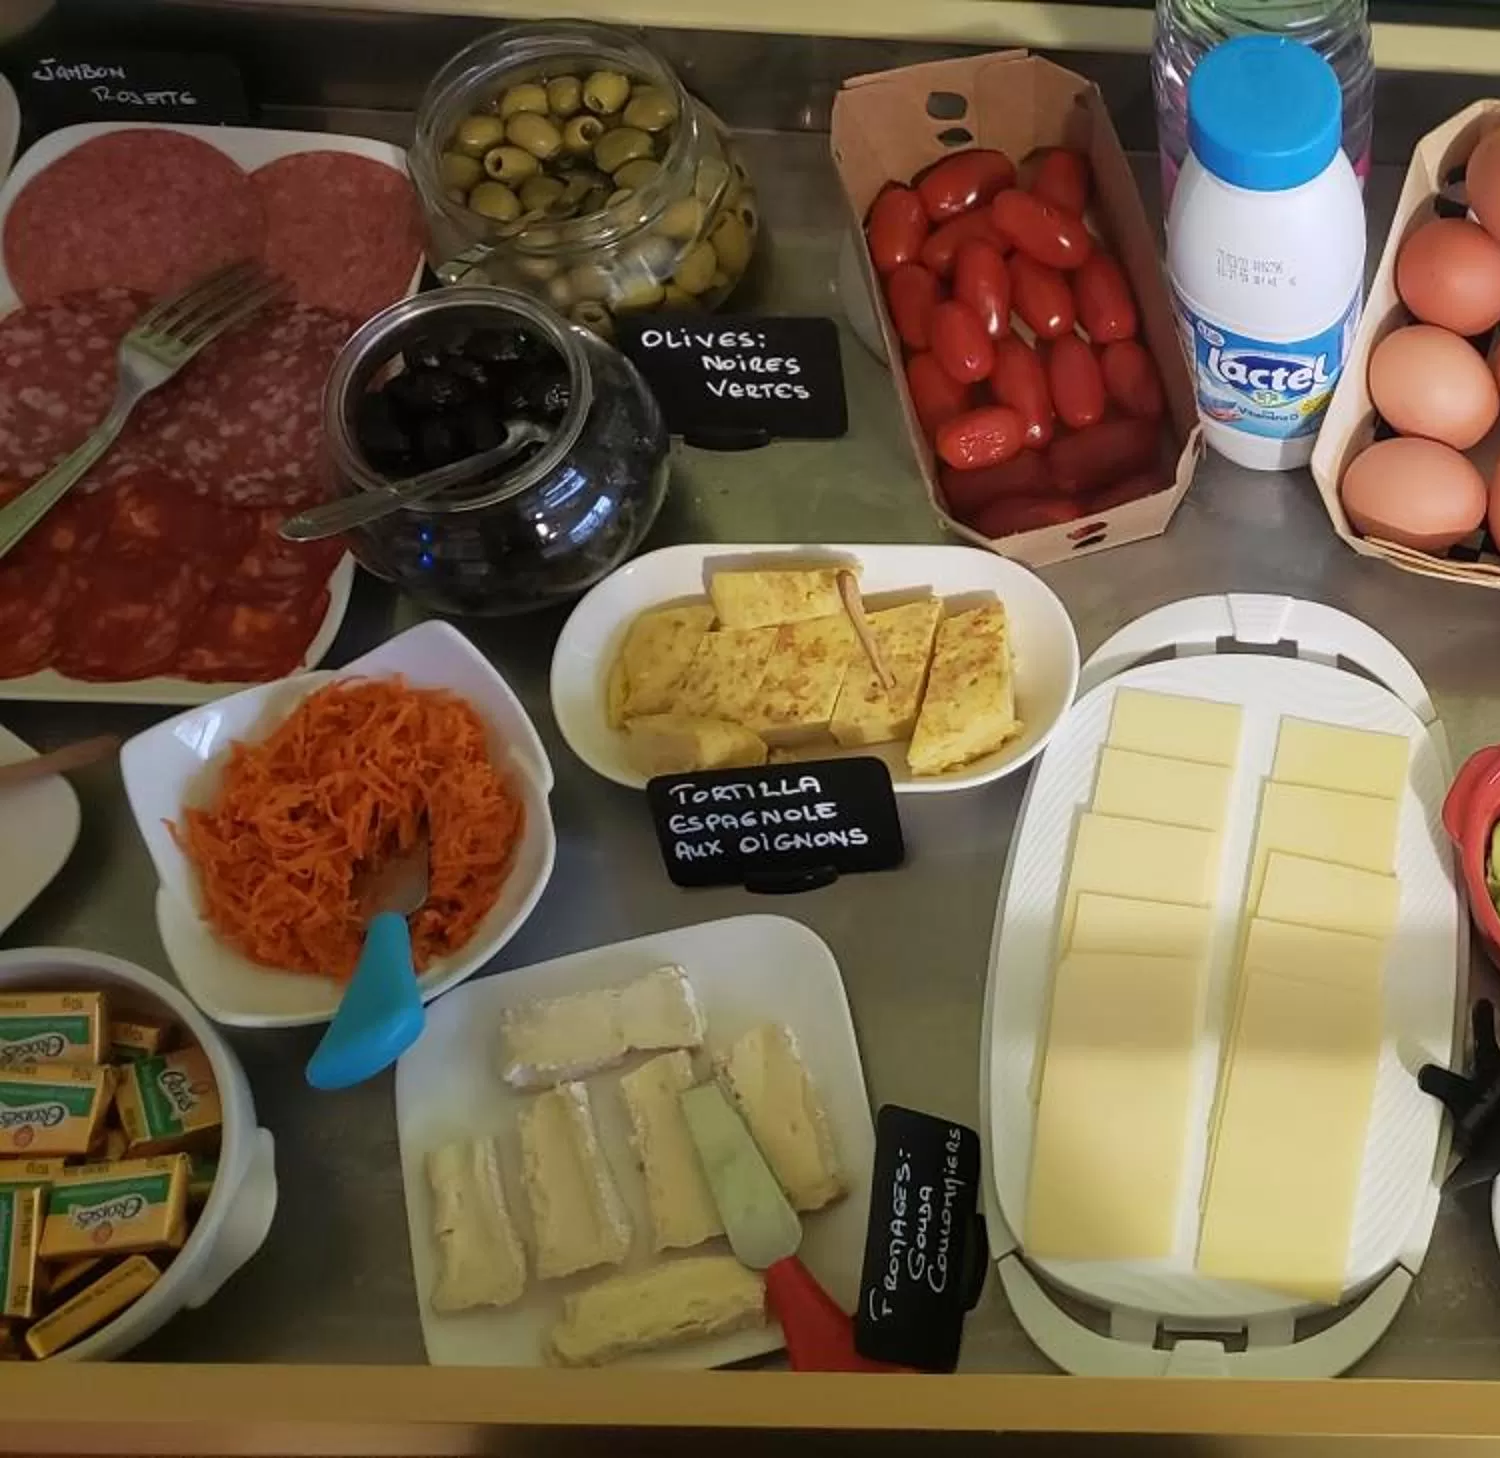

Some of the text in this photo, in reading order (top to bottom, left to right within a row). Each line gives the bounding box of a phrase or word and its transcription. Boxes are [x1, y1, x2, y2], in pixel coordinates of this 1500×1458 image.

[32, 57, 125, 81] JAMBON
[640, 327, 766, 349] OLIVES:
[701, 353, 802, 375] NOIRES
[1208, 347, 1330, 391] lactel
[705, 378, 812, 399] VERTES
[668, 776, 822, 805] TORTILLA
[668, 802, 838, 834] ESPAGNOLE
[674, 828, 869, 861] AUX OIGNONS
[869, 1147, 912, 1322] FROMAGES:
[907, 1185, 934, 1281] GOUDA
